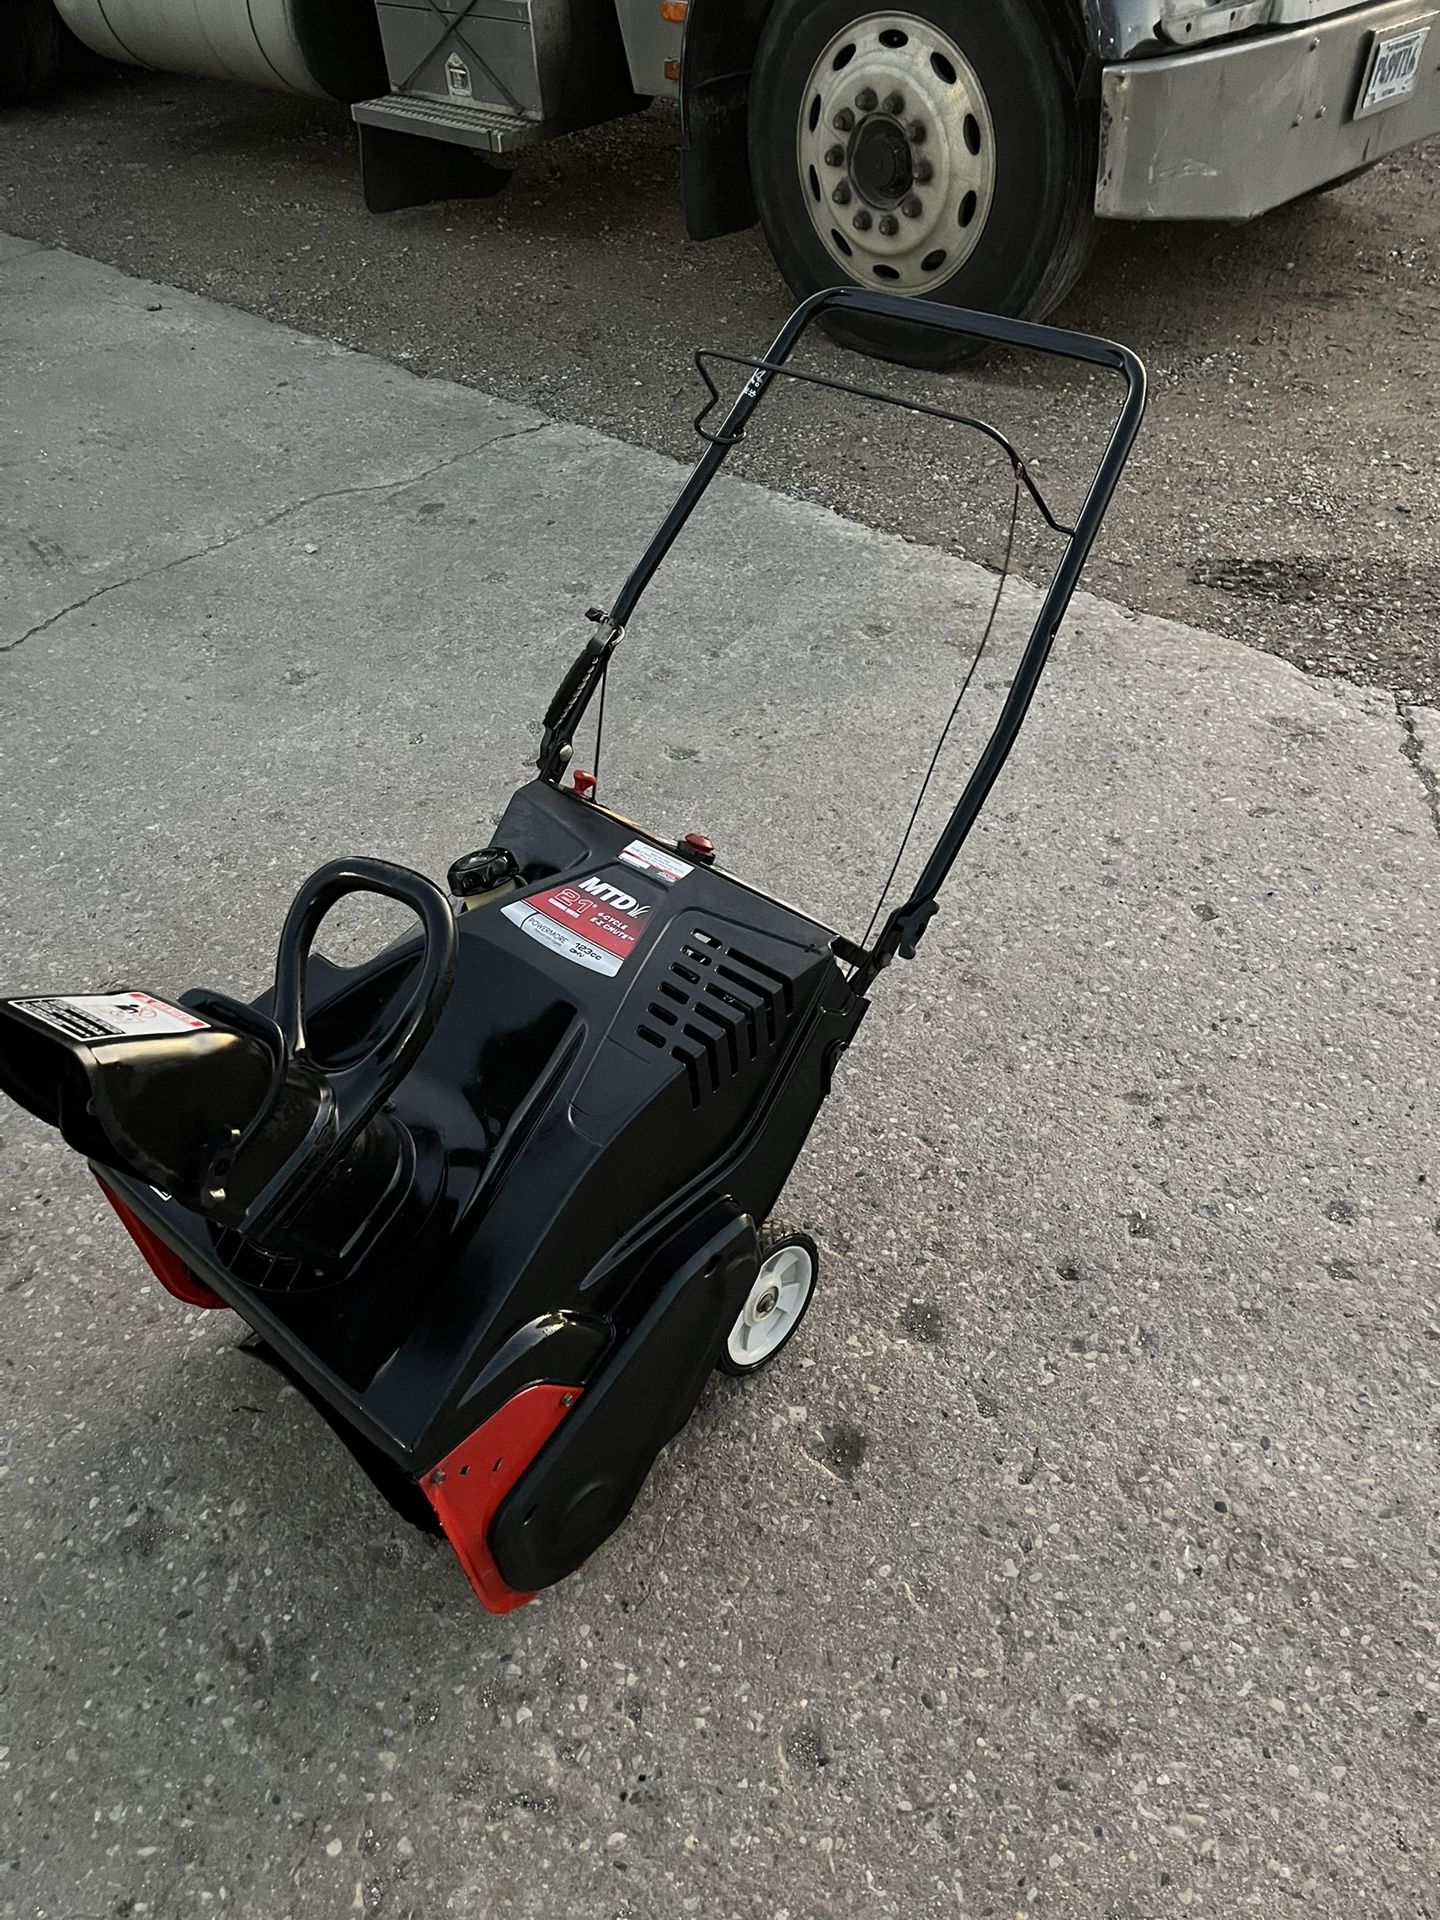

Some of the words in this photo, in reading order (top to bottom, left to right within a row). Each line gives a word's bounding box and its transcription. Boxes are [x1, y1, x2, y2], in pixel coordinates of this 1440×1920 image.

[578, 876, 637, 910] MTD
[597, 912, 629, 931] 4-CYCLE
[575, 942, 602, 960] 123cc
